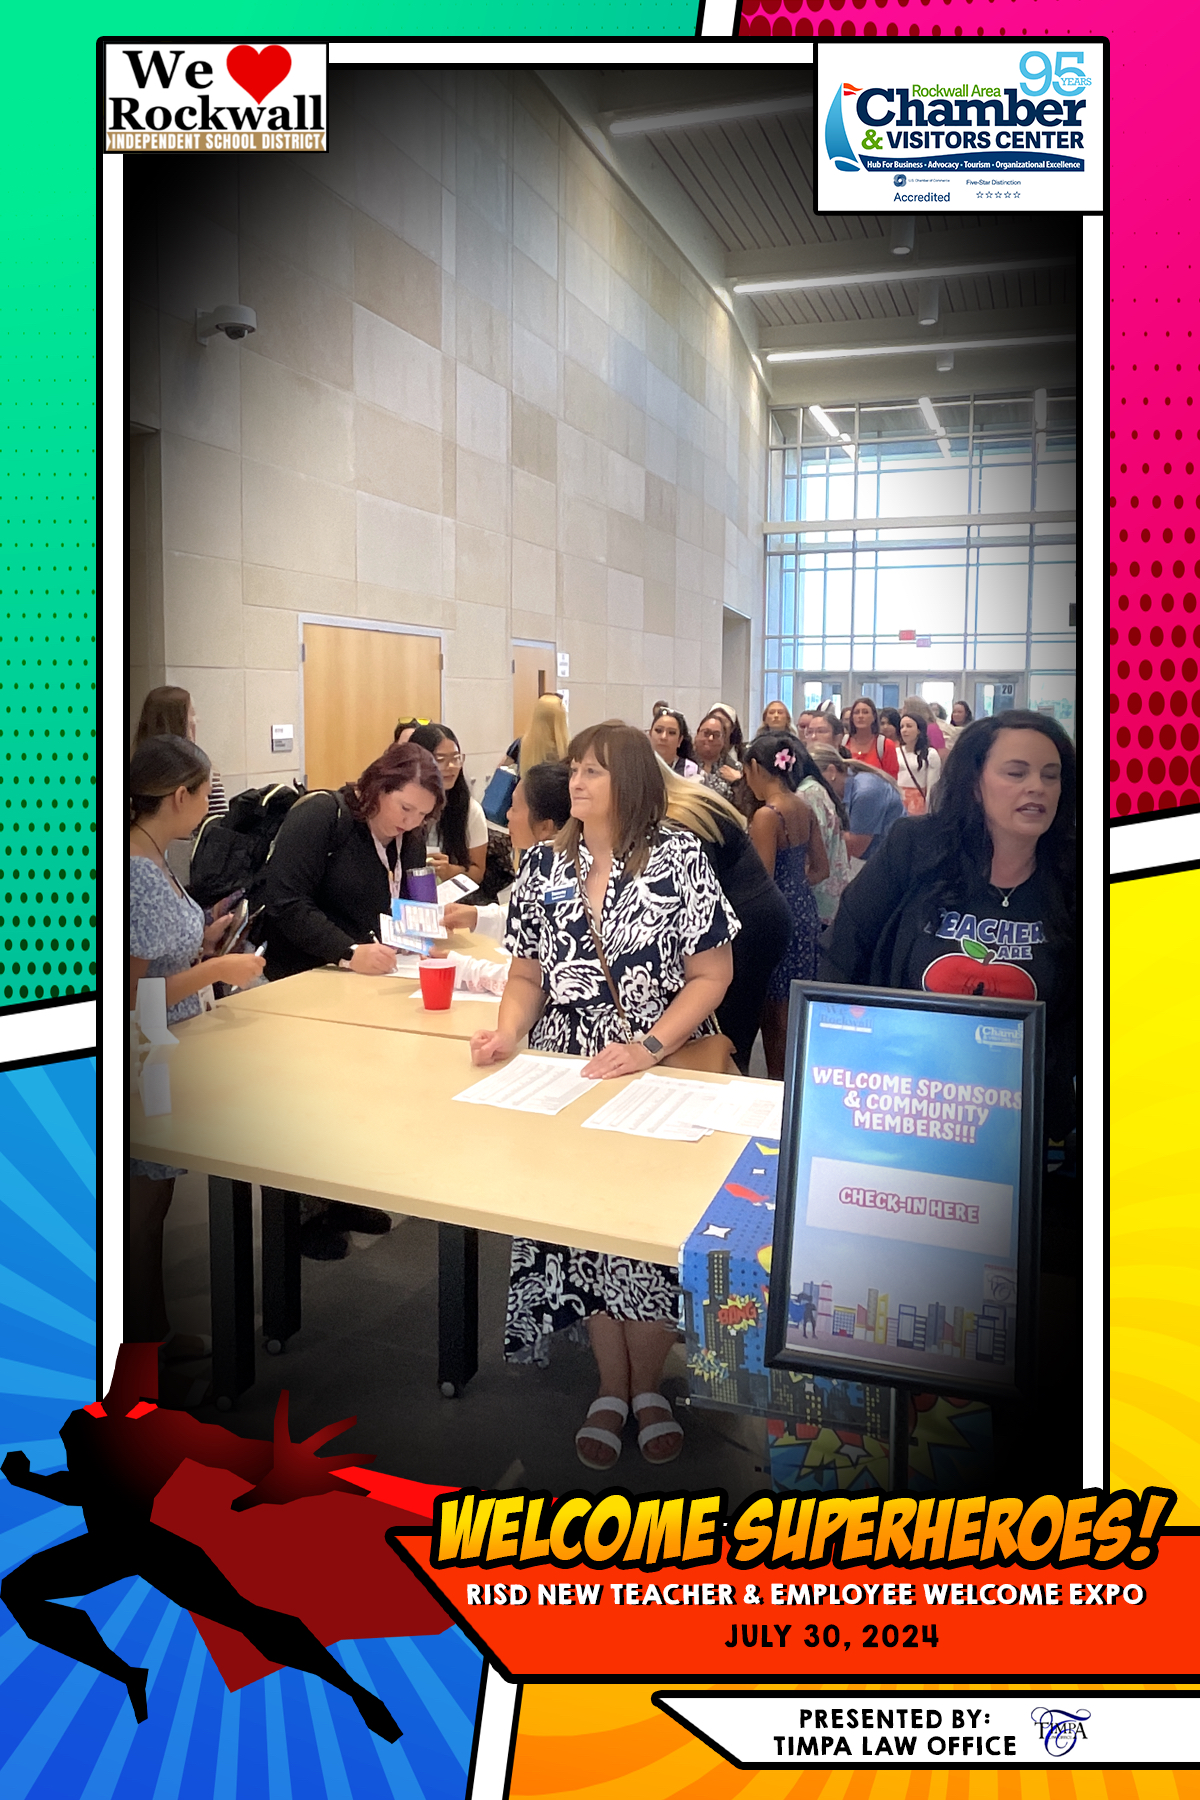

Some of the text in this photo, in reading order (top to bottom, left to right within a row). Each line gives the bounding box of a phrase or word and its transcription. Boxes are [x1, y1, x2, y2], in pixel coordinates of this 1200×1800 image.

[1001, 684, 1013, 695] 20
[997, 945, 1033, 960] ARE
[812, 1066, 1022, 1110] WELCOME SPONSORS
[843, 1090, 990, 1127] & COMMUNITY
[854, 1109, 977, 1144] MEMBERS!!!
[839, 1187, 980, 1224] CHECK-IN HERE
[718, 1301, 758, 1325] BANG
